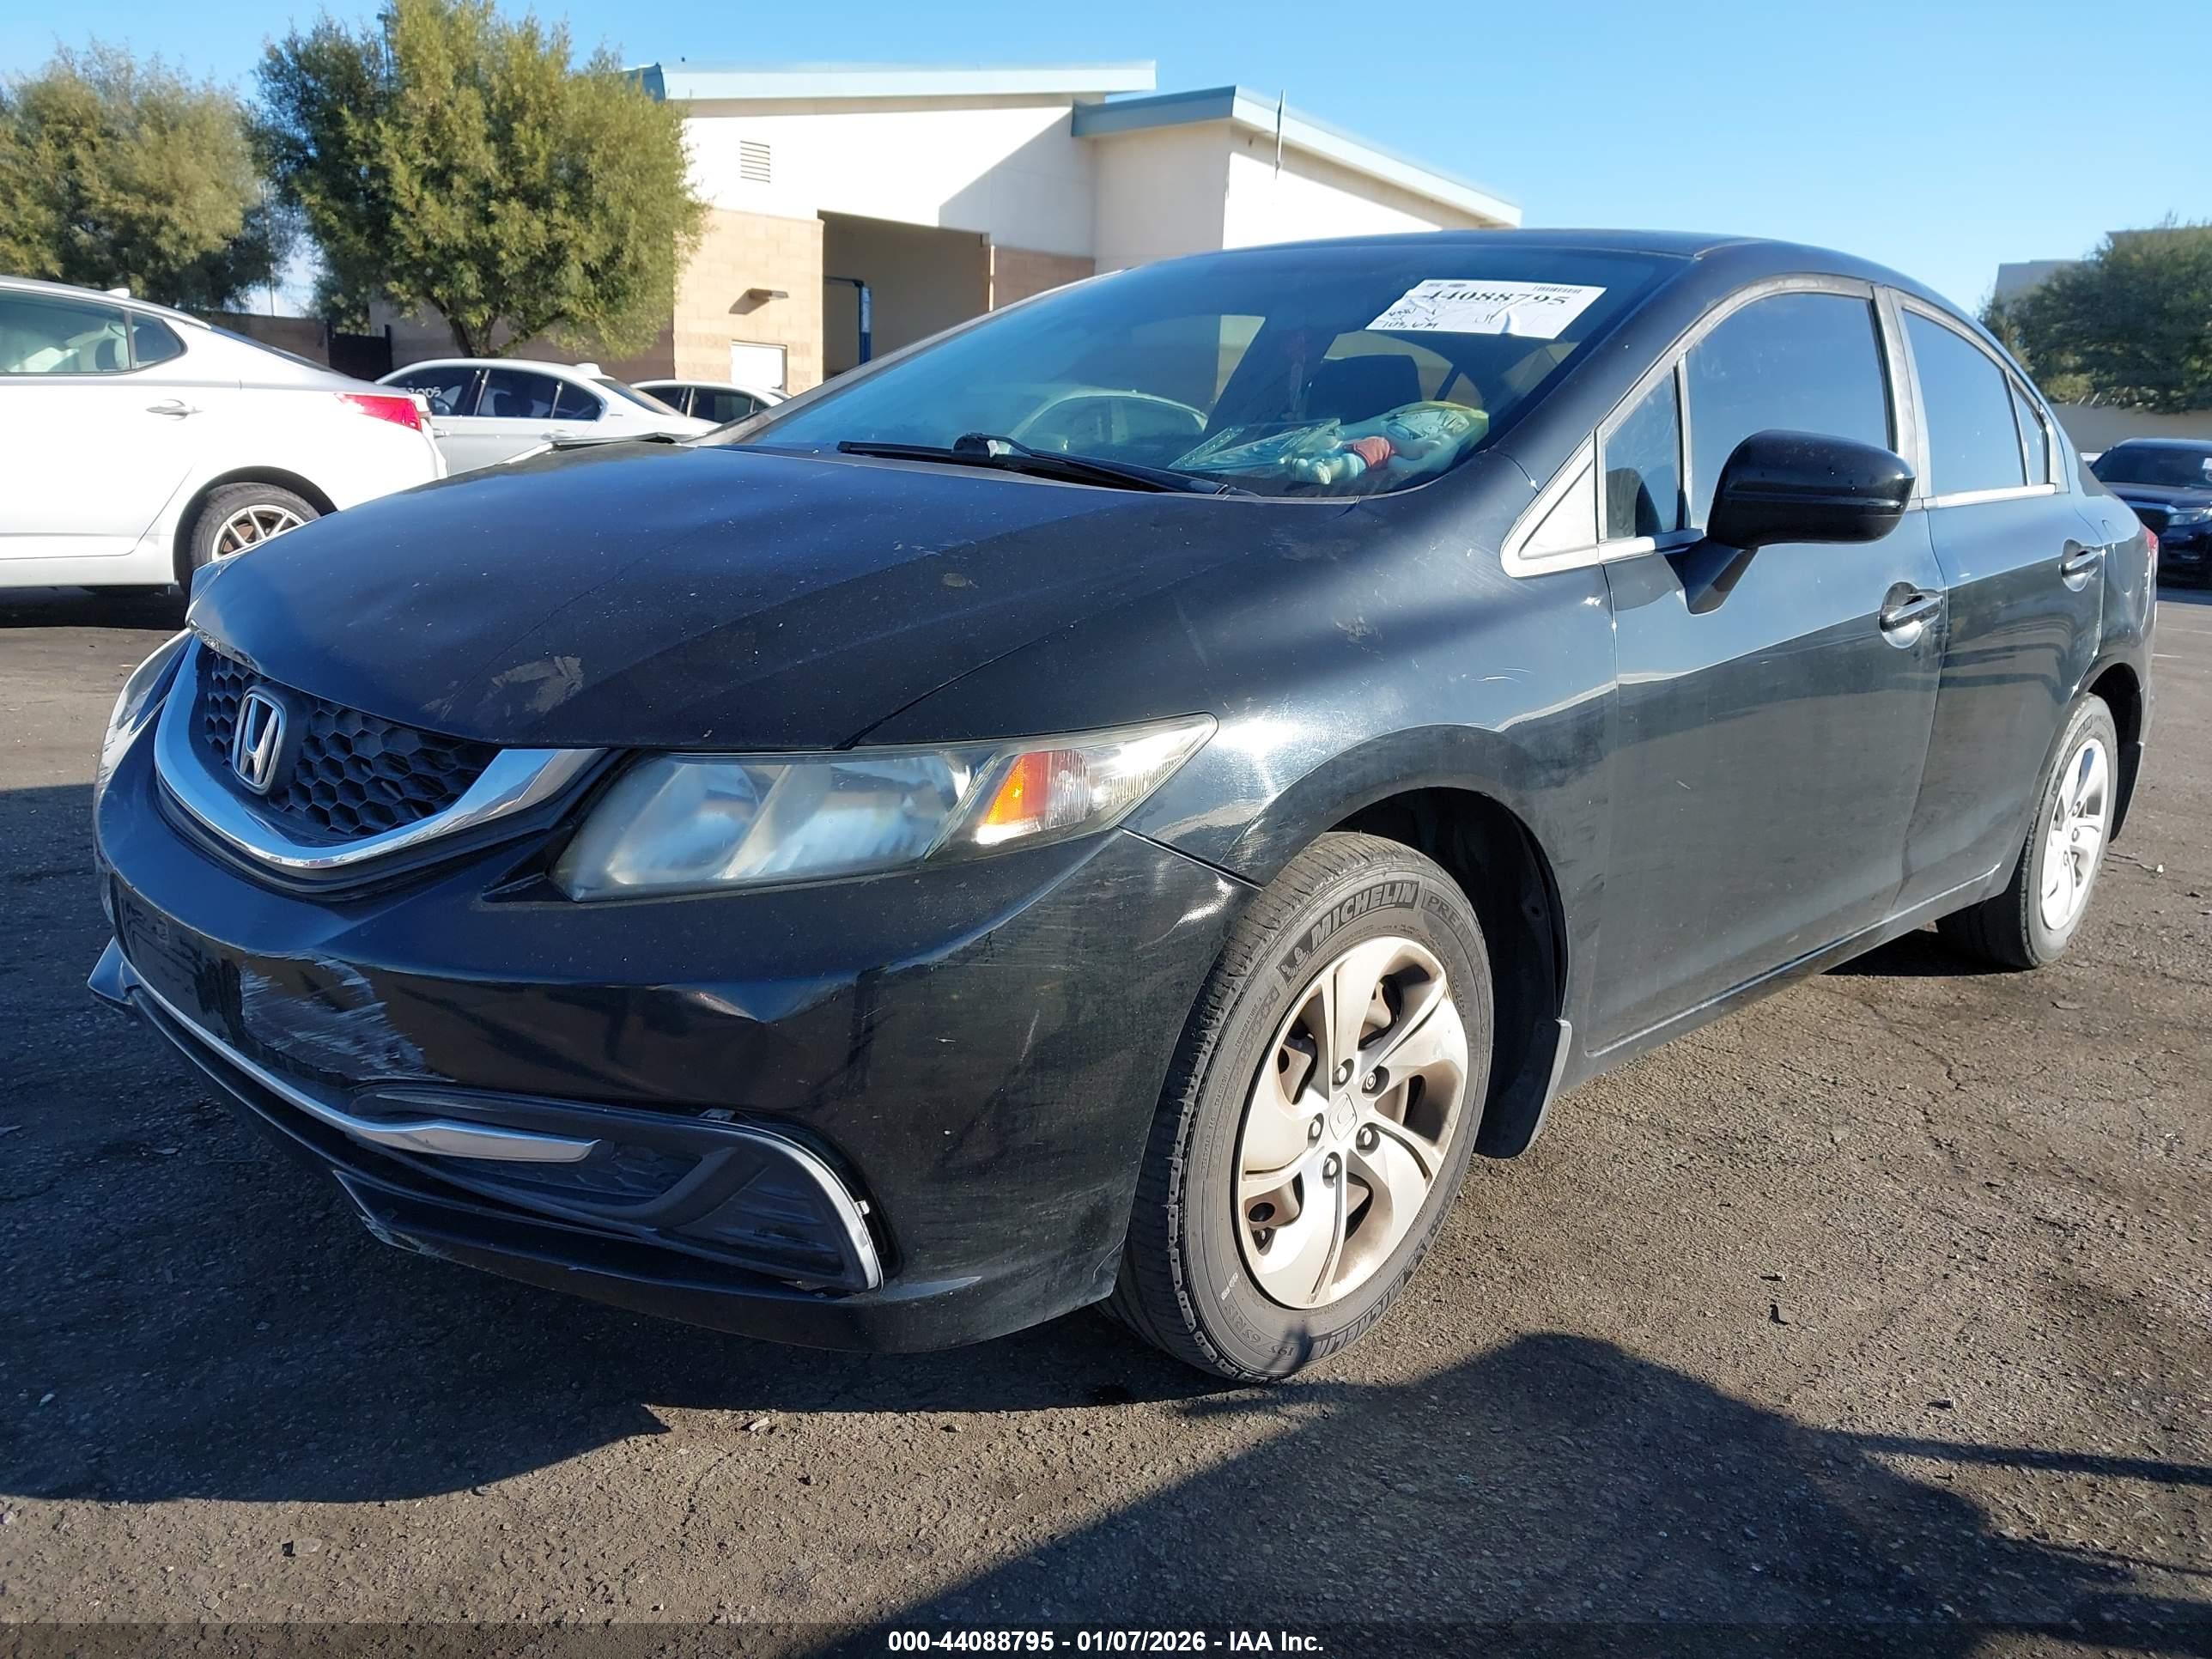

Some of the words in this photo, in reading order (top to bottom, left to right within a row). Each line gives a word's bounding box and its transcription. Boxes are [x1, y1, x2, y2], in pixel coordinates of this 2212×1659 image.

[1422, 289, 1571, 307] 44088795
[1311, 882, 1417, 950] MICHELIN
[1310, 1272, 1406, 1360] MICHELIN
